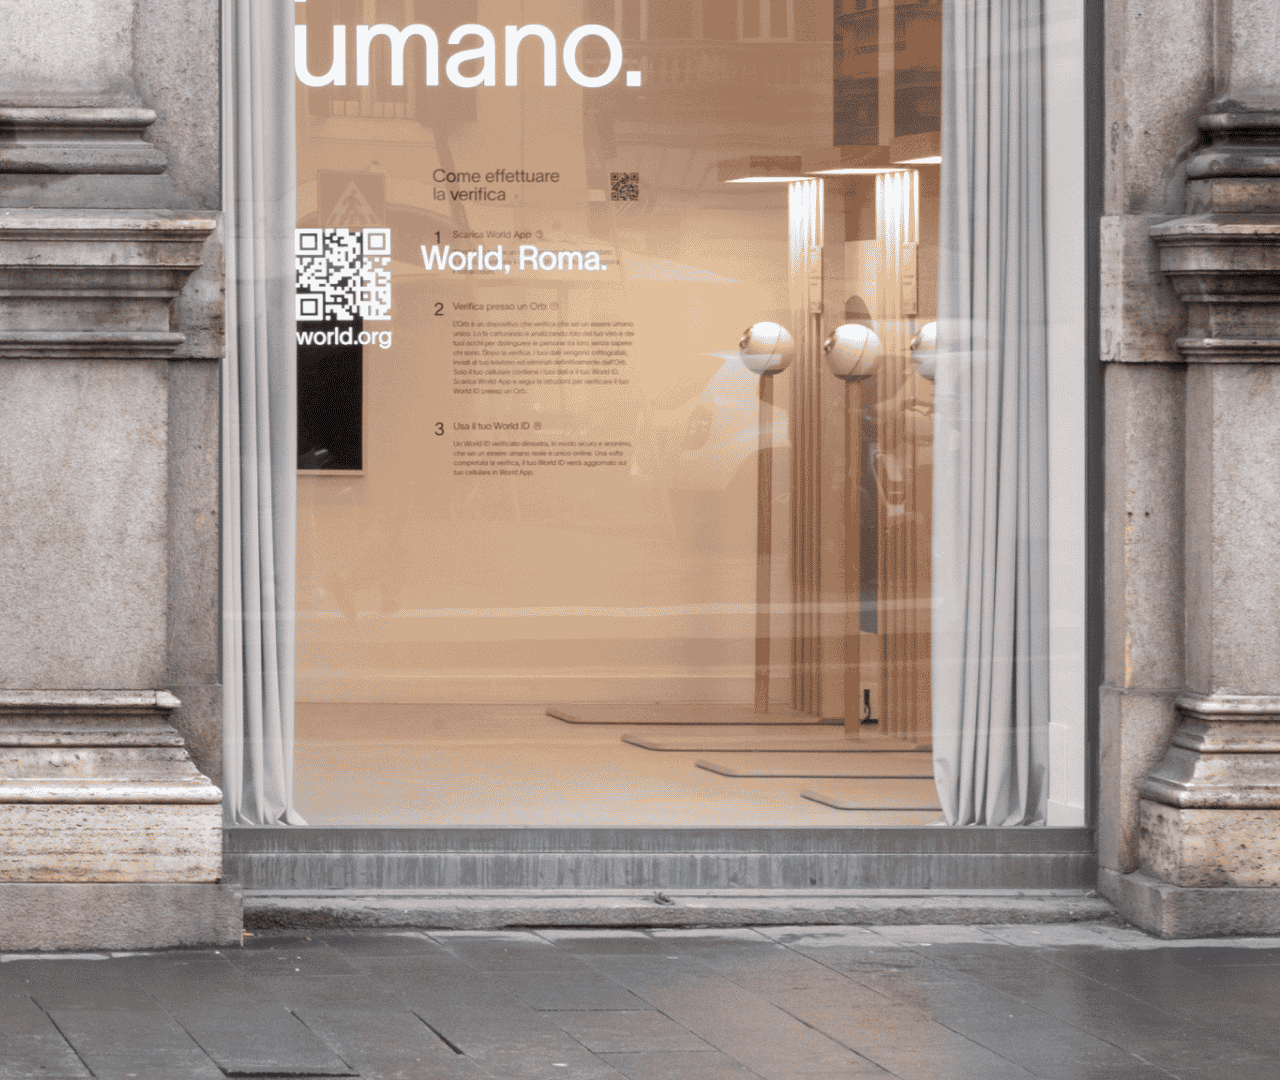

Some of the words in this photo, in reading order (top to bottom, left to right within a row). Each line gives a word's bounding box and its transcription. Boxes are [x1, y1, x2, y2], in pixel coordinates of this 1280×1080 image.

[294, 23, 642, 88] umano.
[433, 168, 481, 183] Come
[485, 168, 560, 183] effettuare
[433, 187, 446, 201] la
[450, 187, 506, 201] verifica
[434, 230, 440, 244] 1
[452, 230, 484, 239] Scarica
[486, 230, 511, 239] World
[514, 230, 532, 242] App
[420, 245, 511, 274] World,
[519, 245, 608, 271] Roma.
[434, 302, 444, 316] 2
[452, 301, 485, 310] Verifica
[486, 303, 515, 312] presso
[530, 301, 547, 310] Orb
[296, 327, 392, 350] world.org
[434, 422, 445, 436] 3
[452, 422, 470, 431] Usa
[471, 422, 476, 430] il
[478, 422, 492, 431] tuo
[493, 422, 519, 431] World
[520, 422, 530, 431] ID
